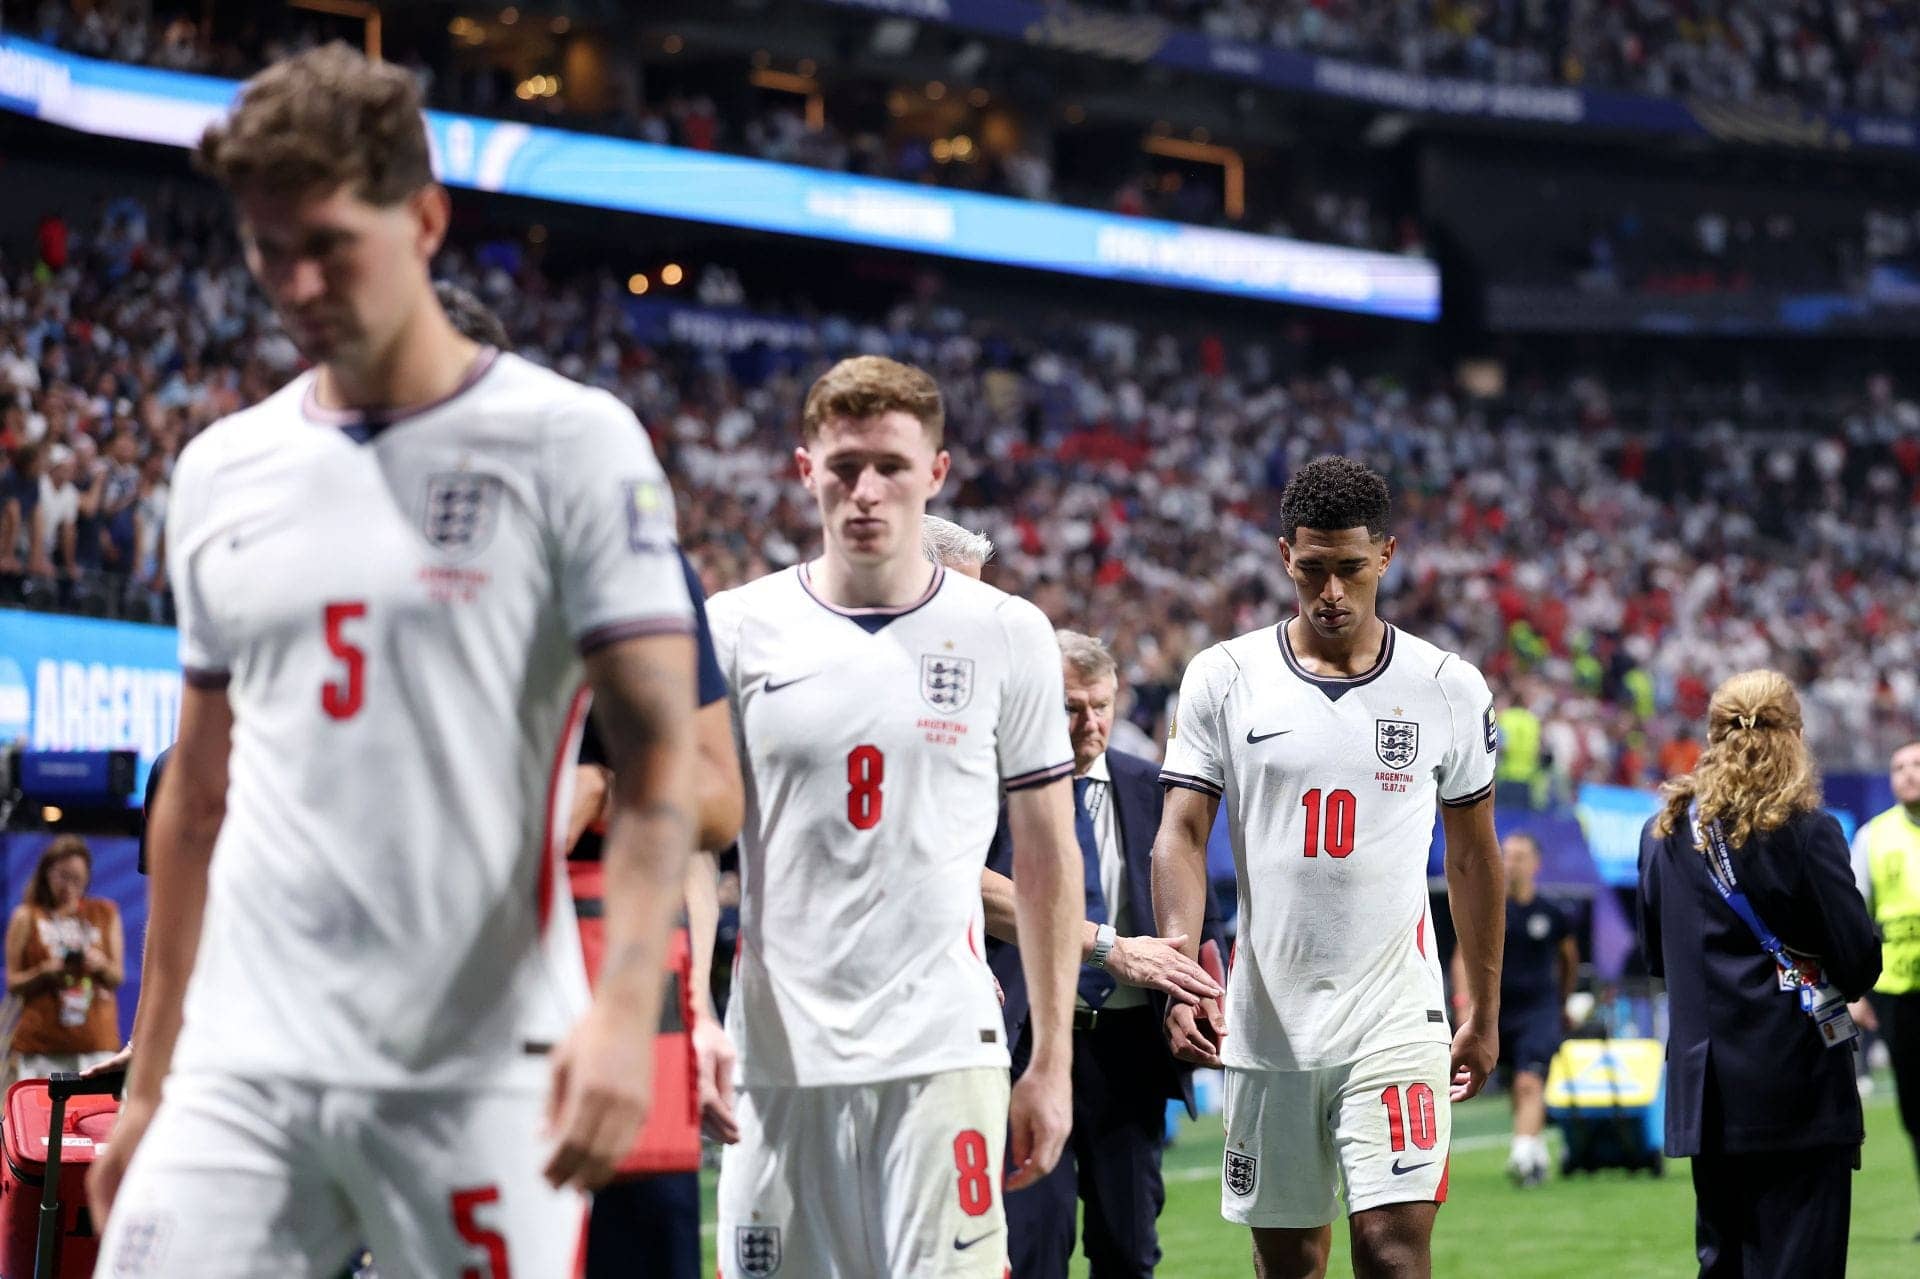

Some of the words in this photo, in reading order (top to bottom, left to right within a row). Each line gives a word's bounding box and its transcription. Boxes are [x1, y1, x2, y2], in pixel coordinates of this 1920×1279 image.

[321, 601, 367, 722] 5
[847, 744, 884, 830] 8
[1374, 771, 1414, 783] ARGENTINA
[1302, 788, 1357, 859] 10
[1381, 1082, 1438, 1152] 10
[952, 1128, 993, 1217] 8
[451, 1185, 510, 1279] 5
